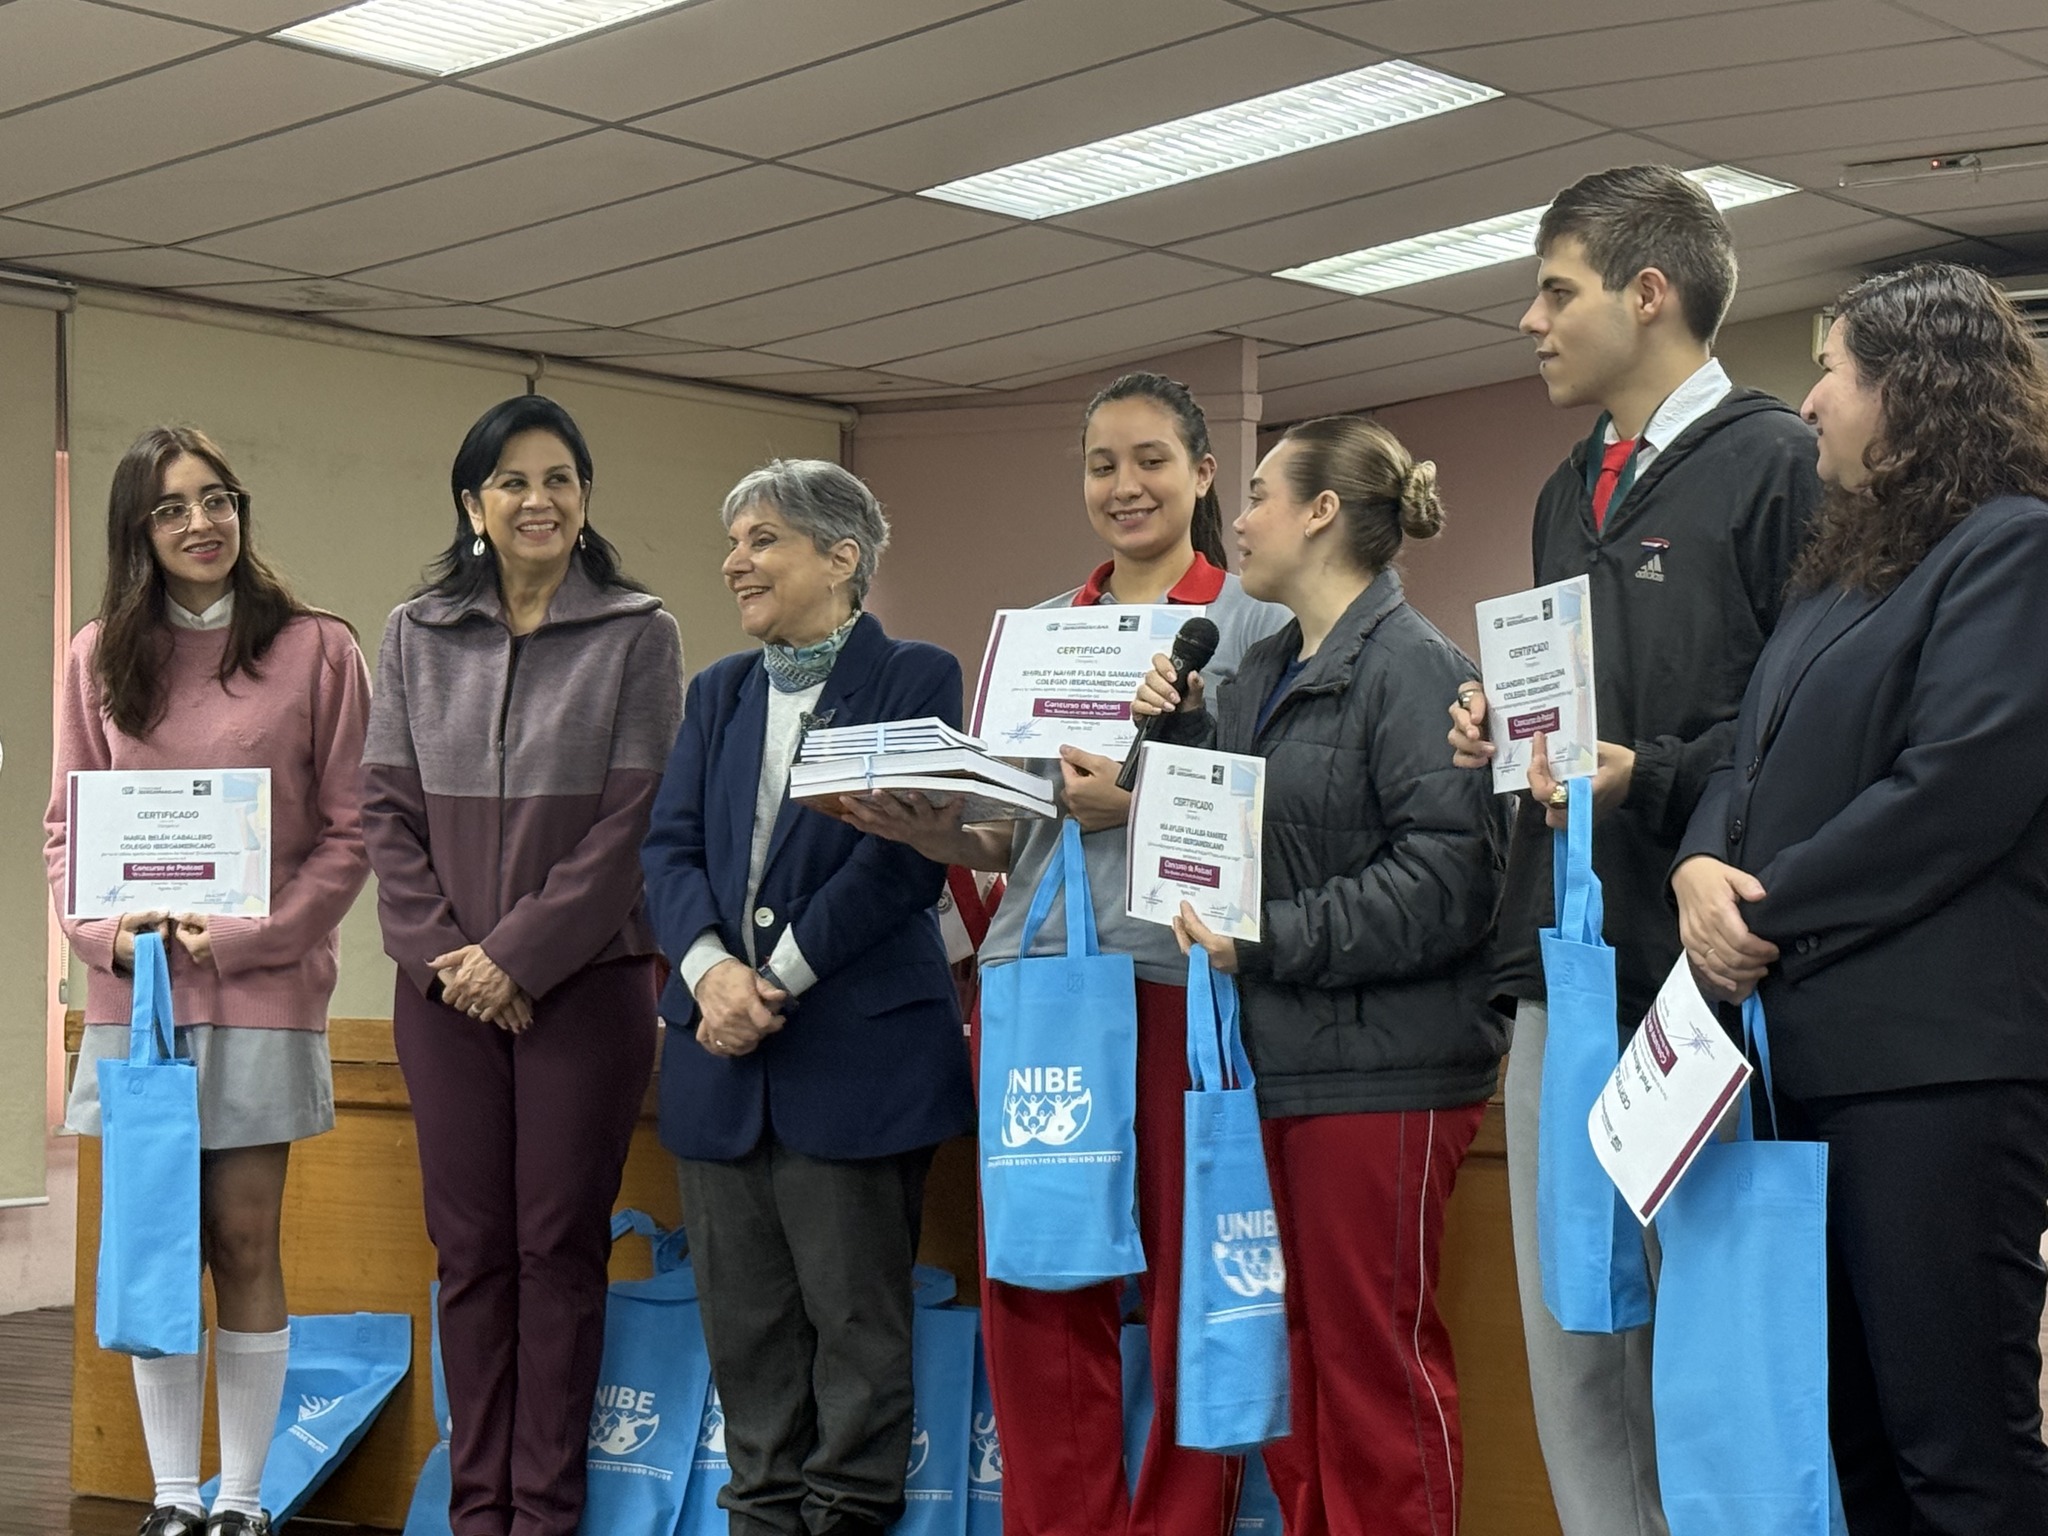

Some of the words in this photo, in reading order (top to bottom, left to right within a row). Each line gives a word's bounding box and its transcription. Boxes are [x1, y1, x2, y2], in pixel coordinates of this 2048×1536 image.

[1057, 646, 1122, 655] CERTIFICADO
[1509, 641, 1549, 659] CERTIFICADO
[1069, 679, 1137, 688] IBEROAMERICANO
[1044, 701, 1080, 709] Concurso
[1092, 702, 1121, 710] Podcast
[1173, 797, 1214, 811] CERTIFICADO
[137, 810, 200, 819] CERTIFICADO
[131, 864, 165, 872] Concurso
[1006, 1066, 1083, 1094] NIBE
[1068, 1156, 1095, 1164] MUNDO
[1216, 1208, 1278, 1242] UNIB
[595, 1384, 656, 1414] NIBE
